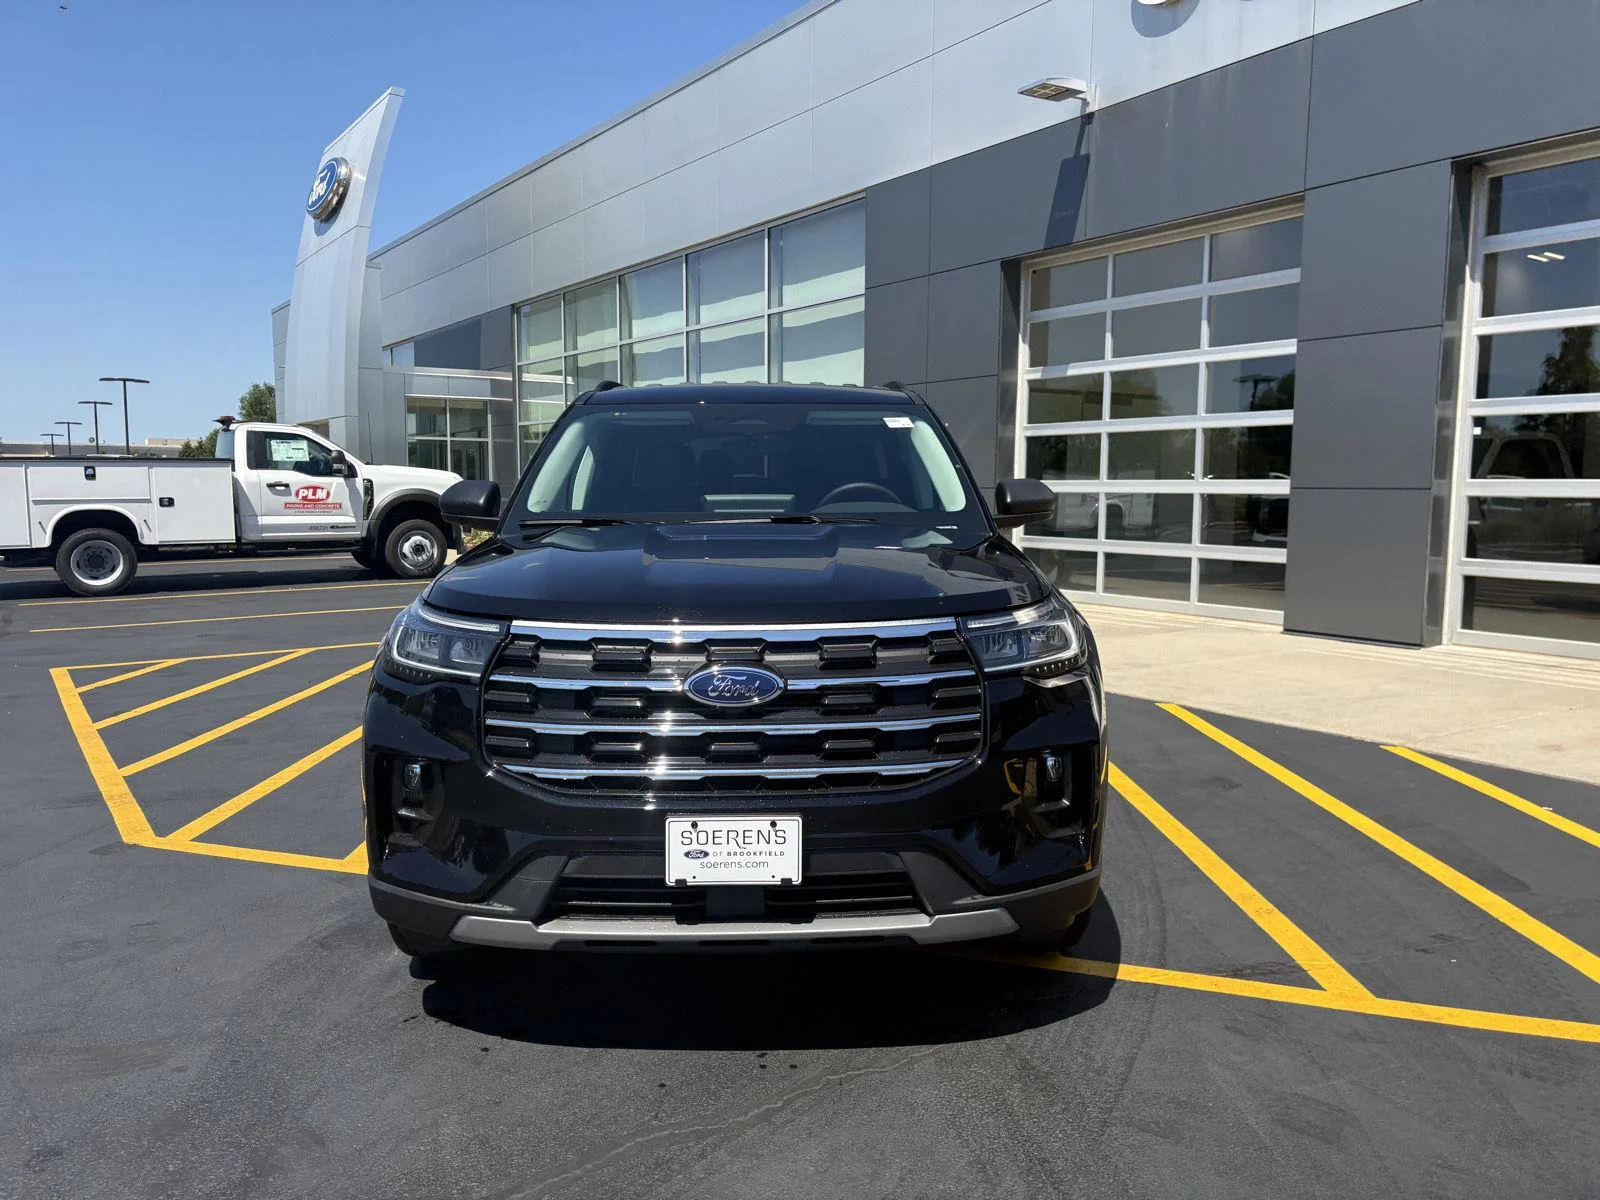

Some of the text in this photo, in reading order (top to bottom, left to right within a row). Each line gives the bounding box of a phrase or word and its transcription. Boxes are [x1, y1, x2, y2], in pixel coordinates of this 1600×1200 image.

[308, 169, 331, 206] Ford
[298, 488, 328, 500] PLM
[708, 674, 760, 697] Ford
[681, 829, 787, 850] SOERENS
[699, 860, 769, 869] soerens.com
